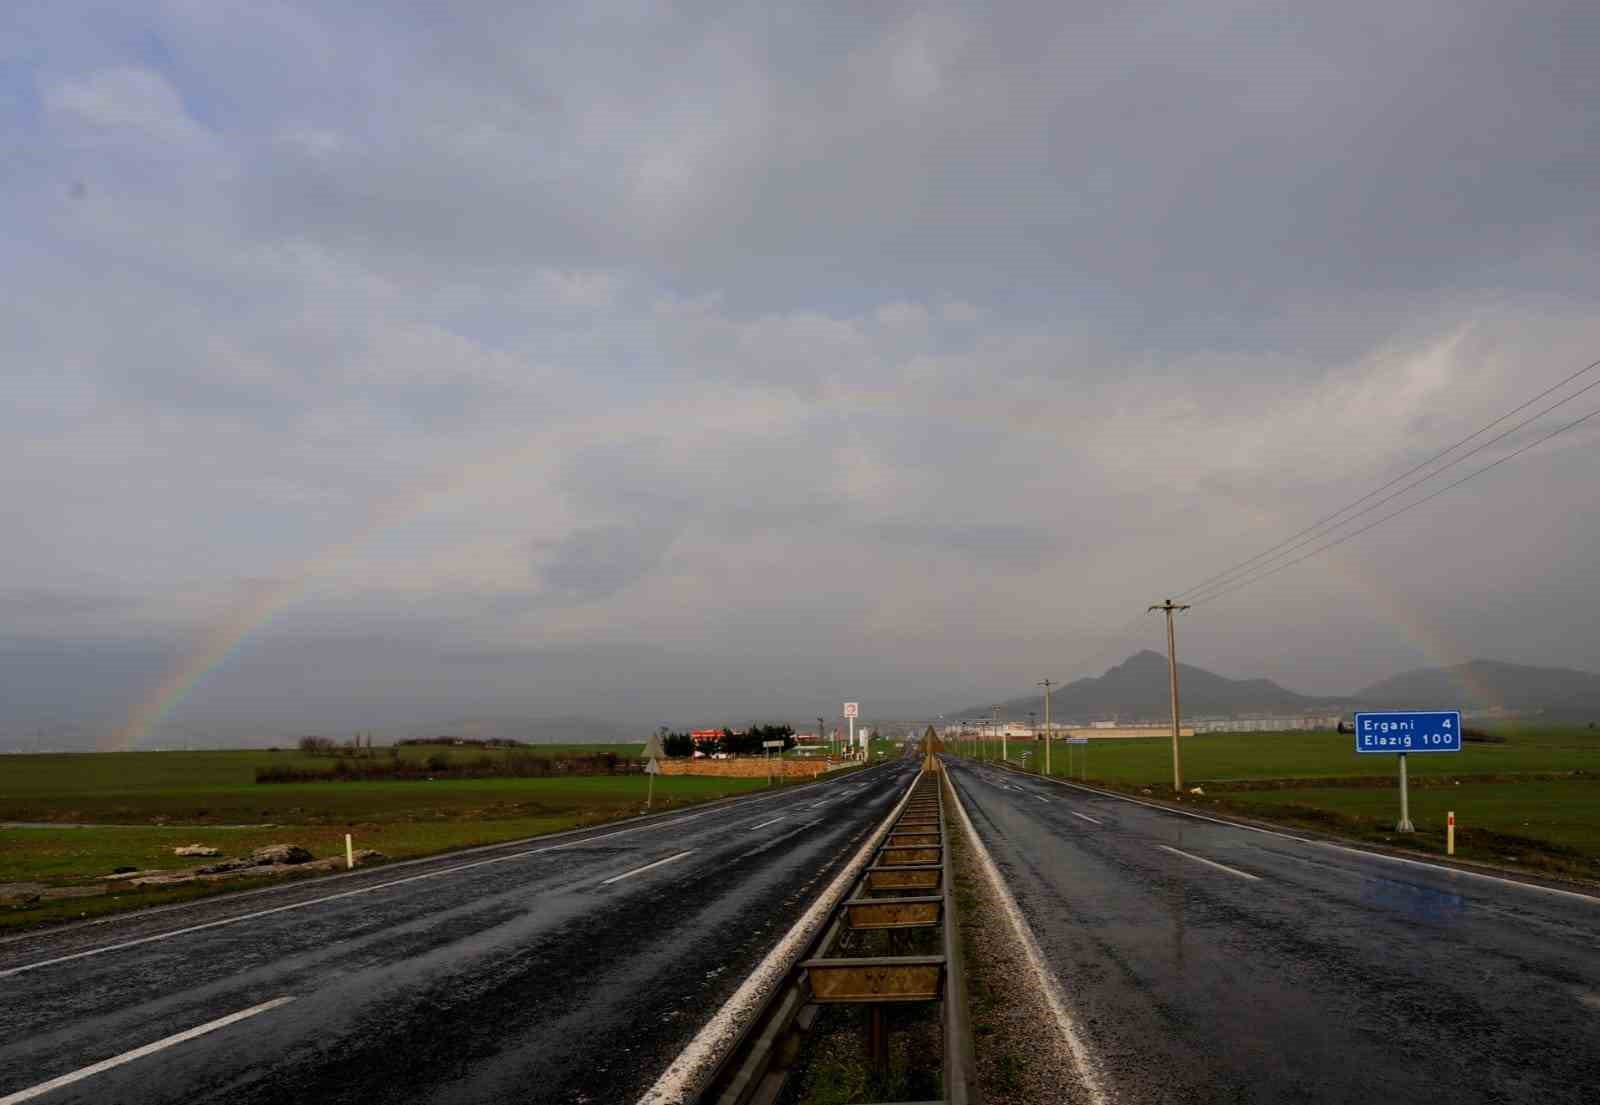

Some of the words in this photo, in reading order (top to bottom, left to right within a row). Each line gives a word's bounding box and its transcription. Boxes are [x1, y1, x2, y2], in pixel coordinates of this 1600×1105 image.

[1364, 720, 1415, 733] Ergani
[1442, 719, 1452, 728] 4
[1364, 734, 1412, 747] Elazığ
[1423, 733, 1453, 745] 100
